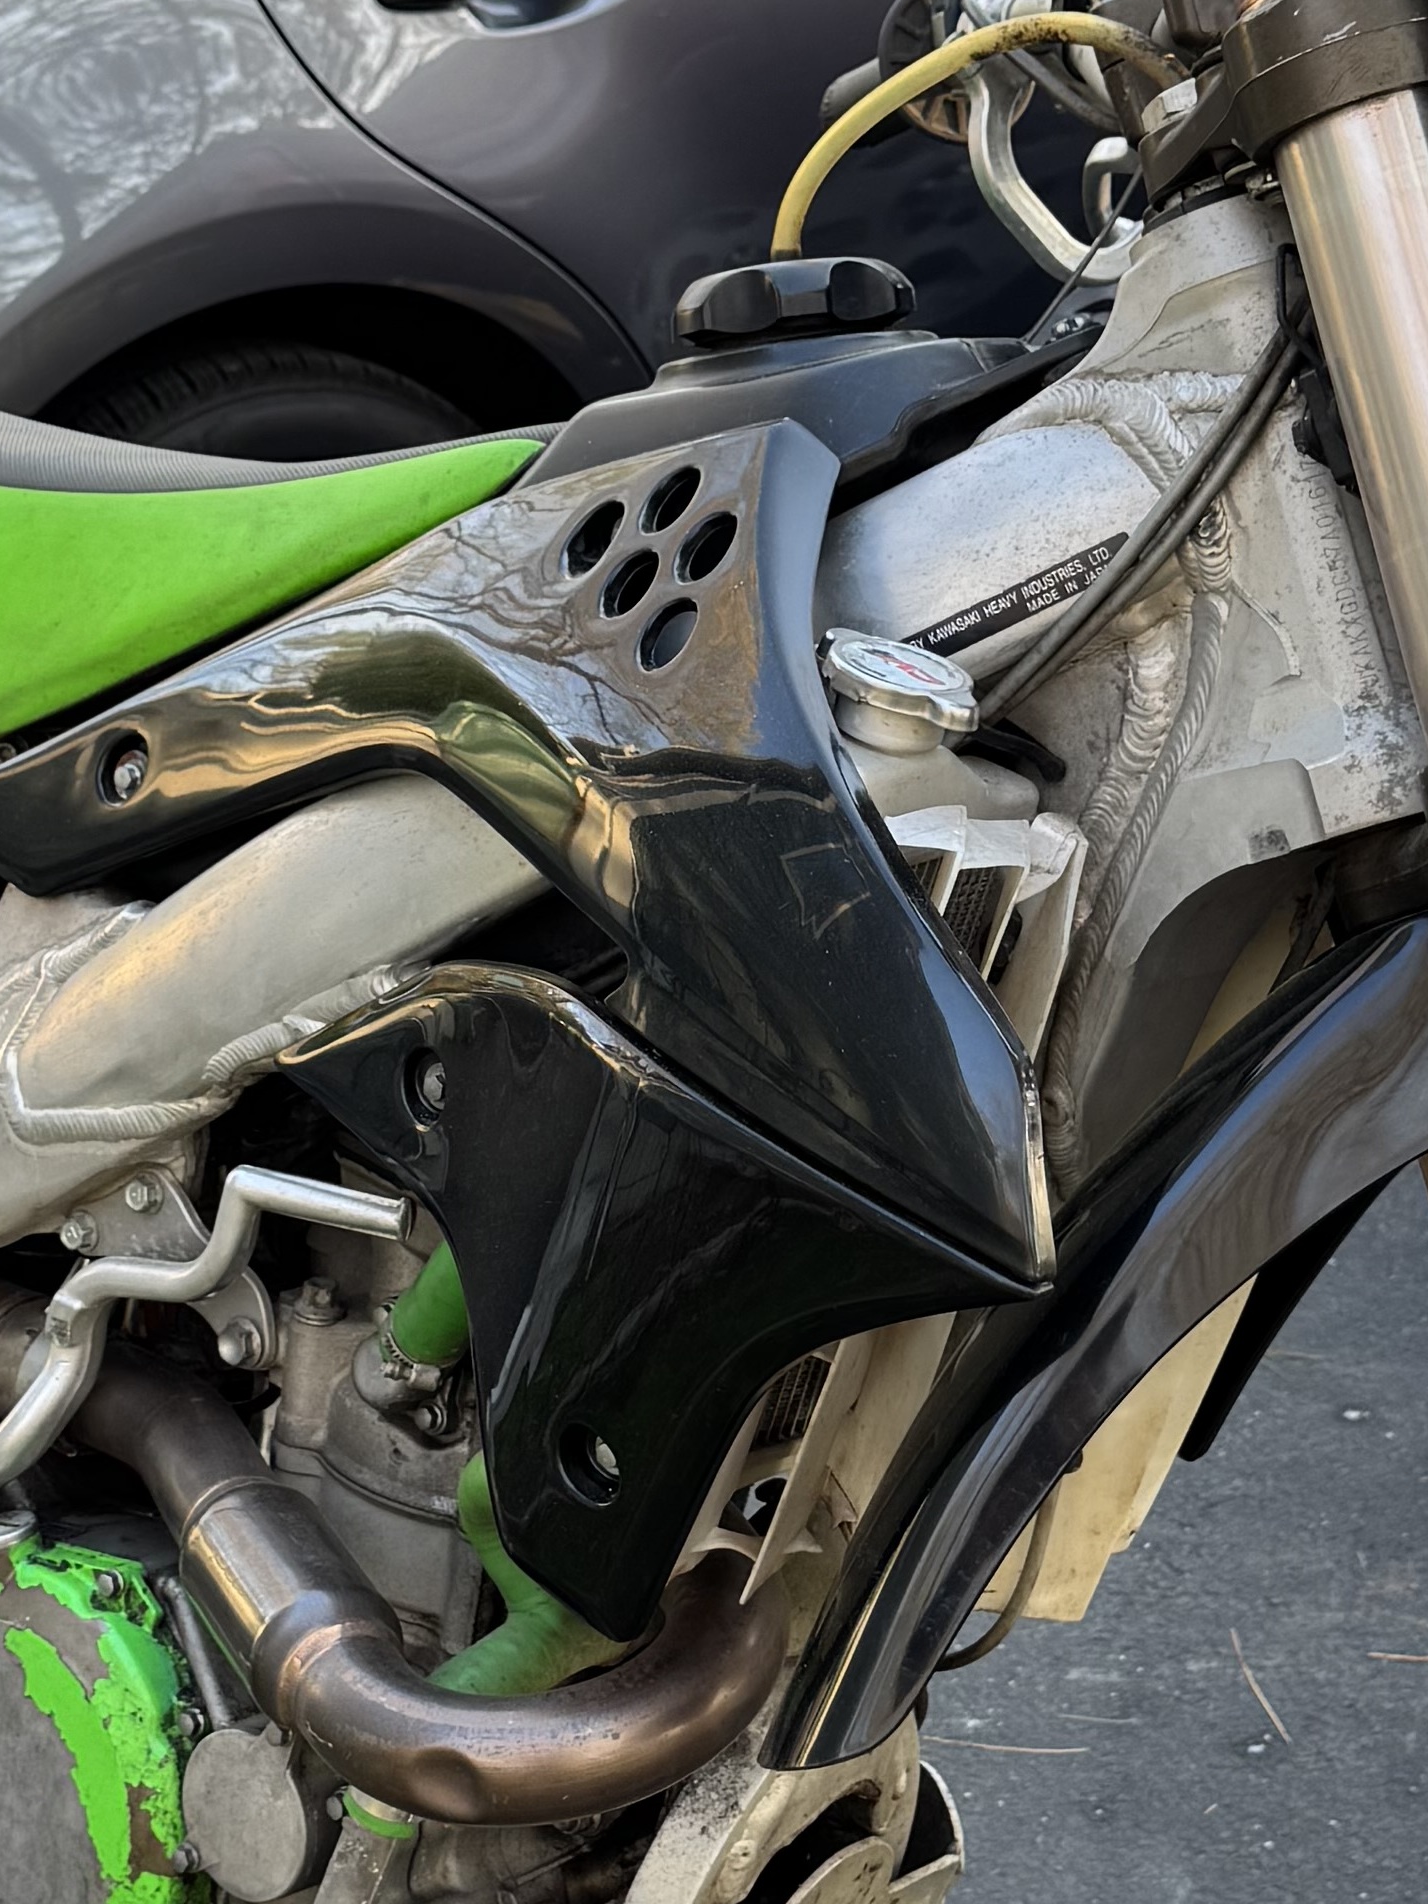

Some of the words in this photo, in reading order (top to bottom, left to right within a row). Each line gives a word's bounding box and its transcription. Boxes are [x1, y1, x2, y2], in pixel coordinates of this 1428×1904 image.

[927, 610, 982, 645] KAWASAKI
[983, 591, 1018, 618] HEAVY
[1088, 547, 1113, 566] LTD.
[1026, 588, 1061, 613] MADE
[1064, 579, 1079, 594] IN
[1084, 564, 1108, 585] JAP
